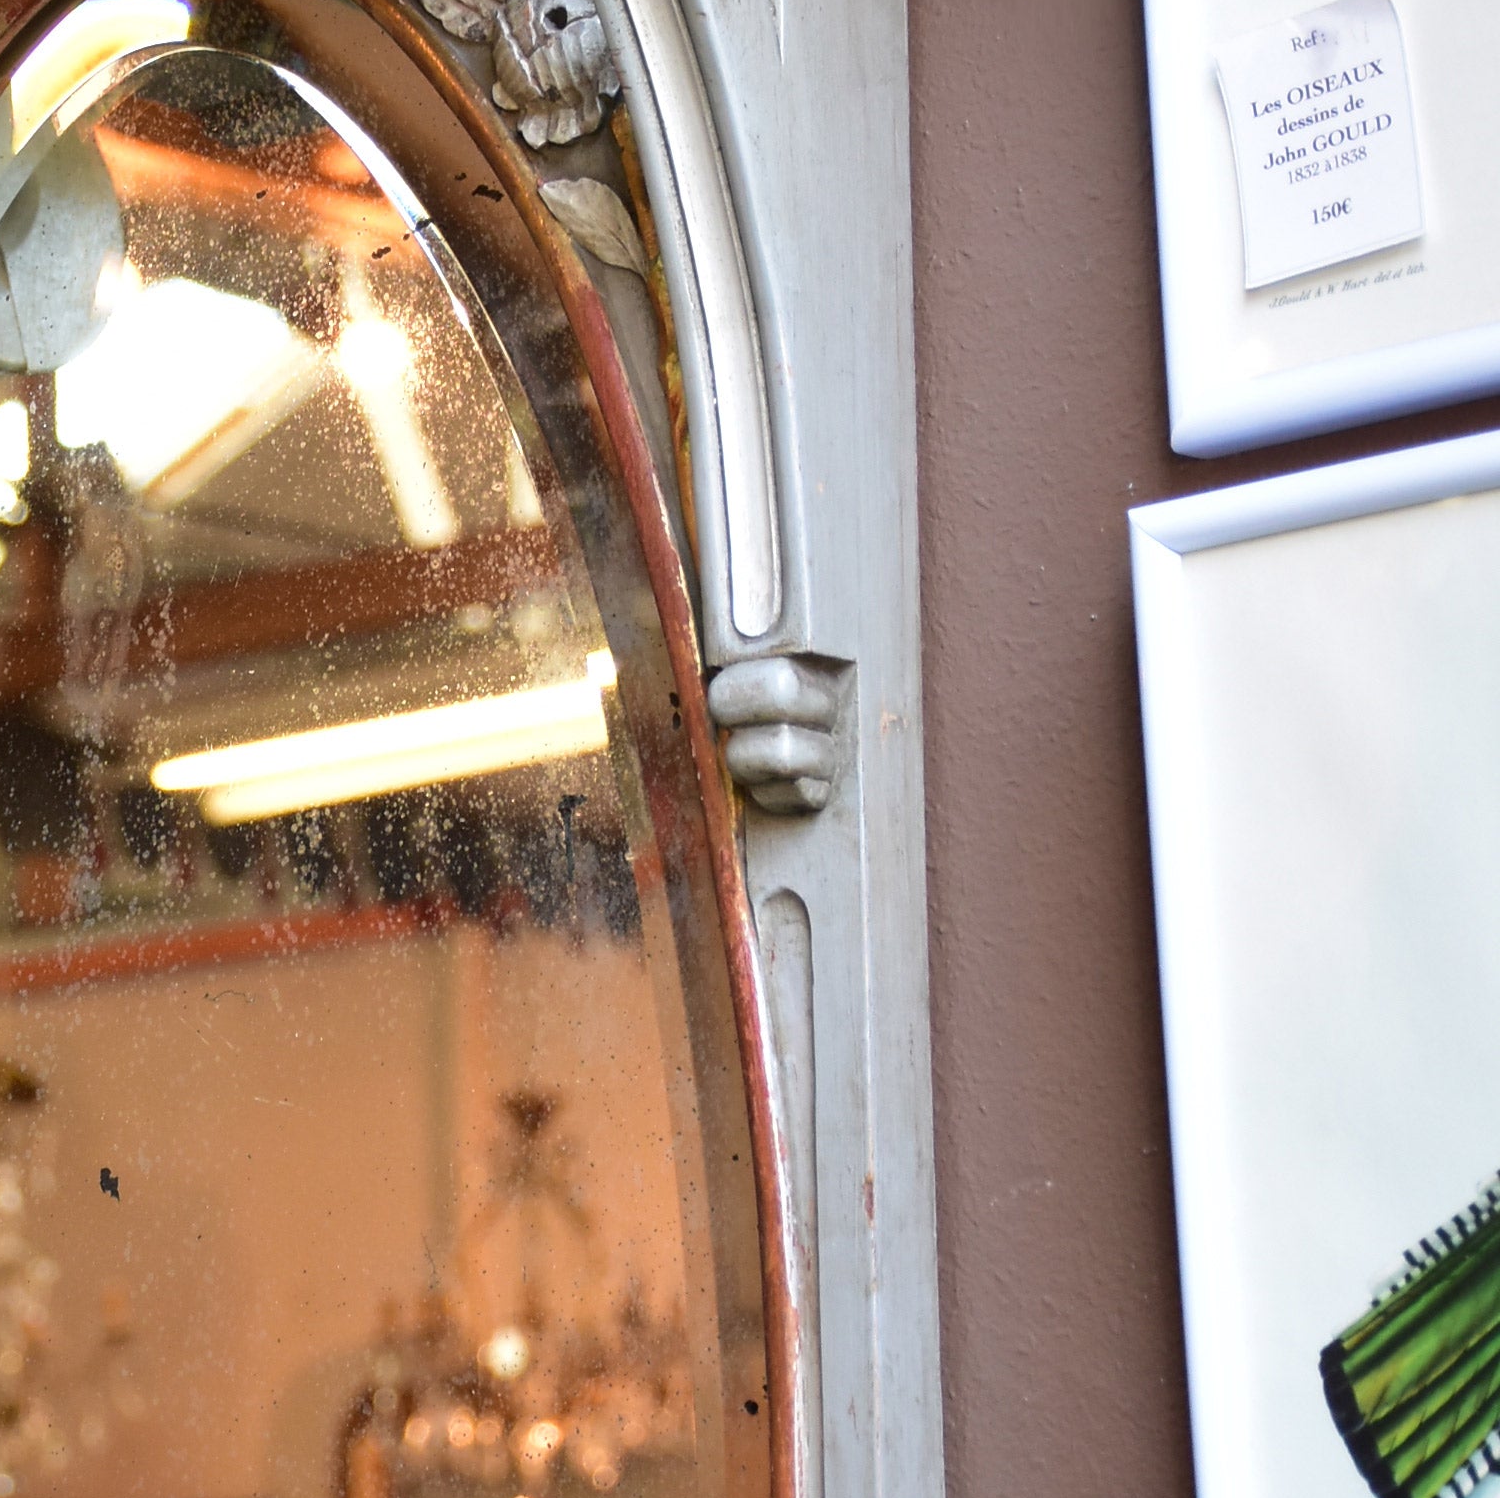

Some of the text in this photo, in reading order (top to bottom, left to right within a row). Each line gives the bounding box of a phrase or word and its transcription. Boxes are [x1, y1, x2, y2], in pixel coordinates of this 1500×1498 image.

[1251, 59, 1384, 118] Les OISEAUX
[1277, 94, 1365, 136] dessins de
[1263, 113, 1392, 170] John GOULD
[1288, 162, 1320, 184] 1832
[1313, 197, 1353, 224] 150€
